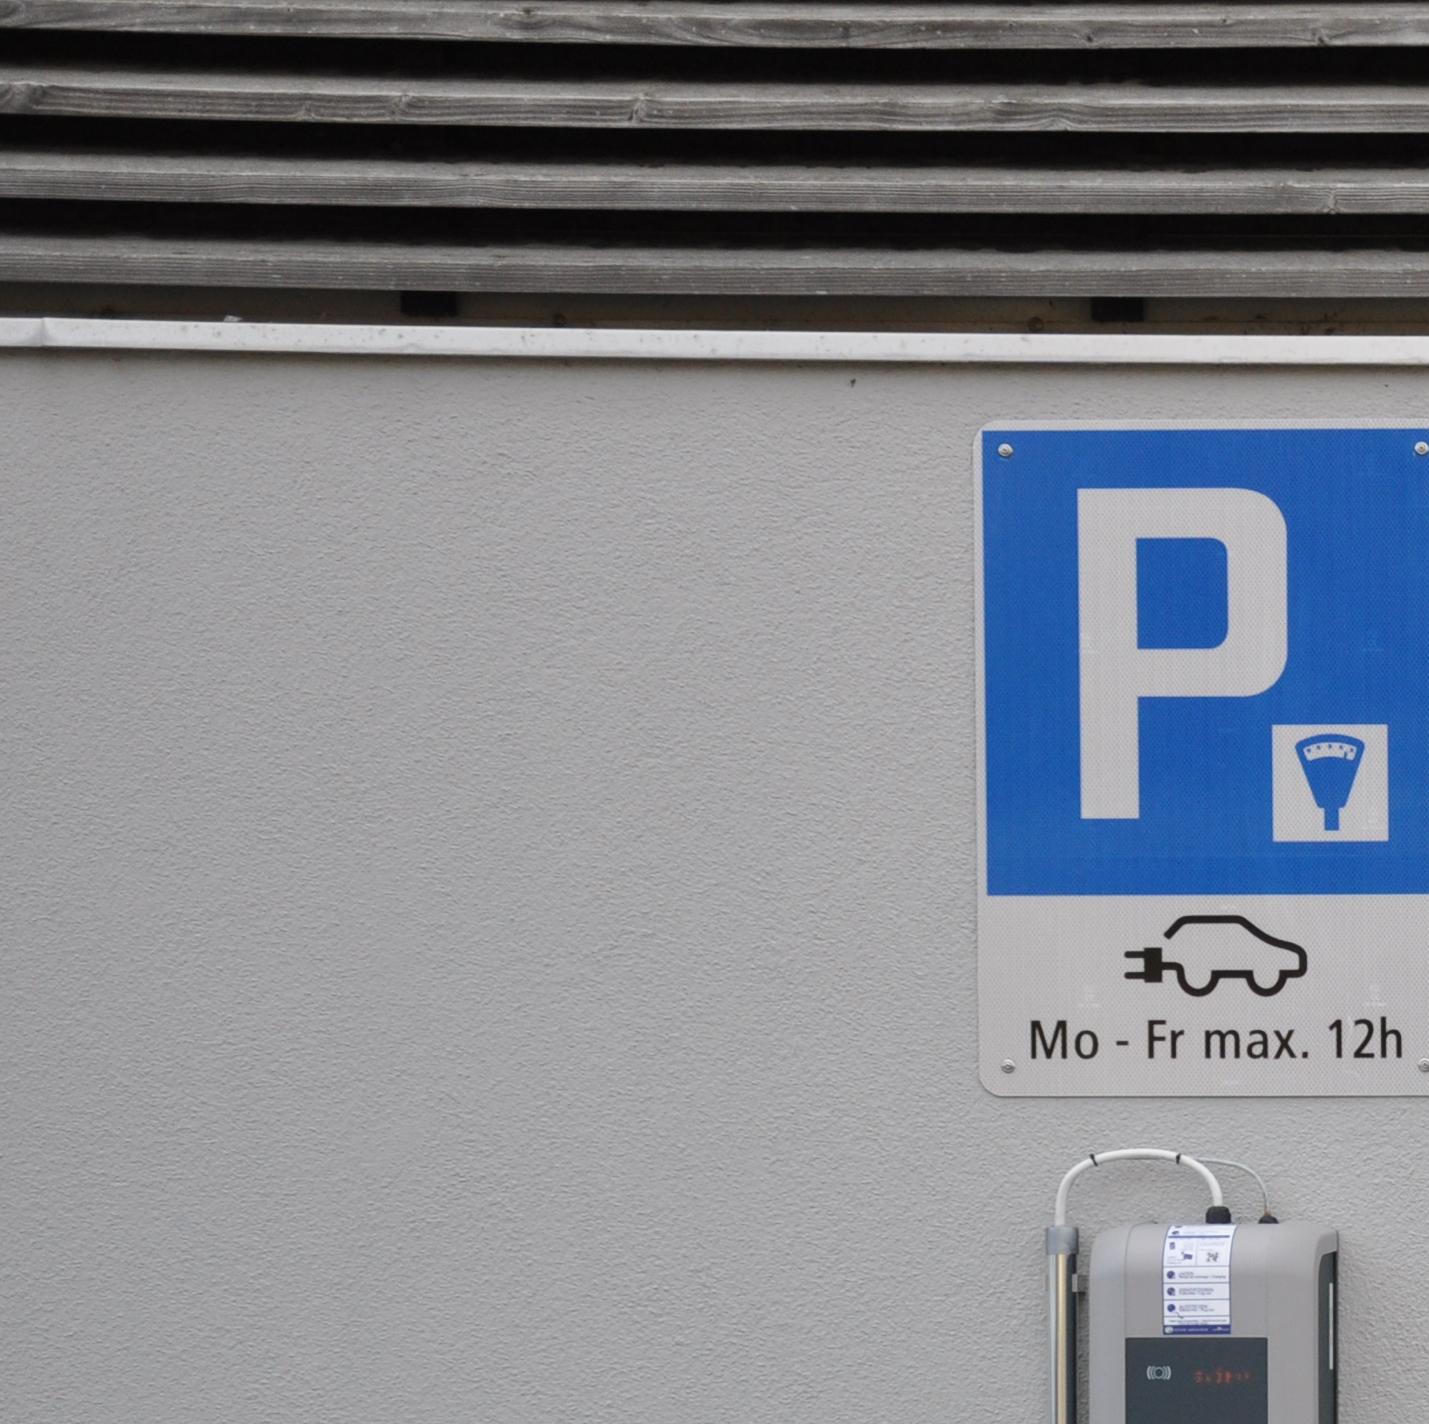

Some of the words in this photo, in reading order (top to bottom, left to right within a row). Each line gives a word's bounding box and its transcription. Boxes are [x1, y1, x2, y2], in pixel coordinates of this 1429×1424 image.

[1076, 487, 1288, 820] P
[1030, 1019, 1099, 1060] Mo
[1147, 1019, 1185, 1059] Fr
[1204, 1029, 1309, 1060] max.
[1328, 1016, 1403, 1059] 12h
